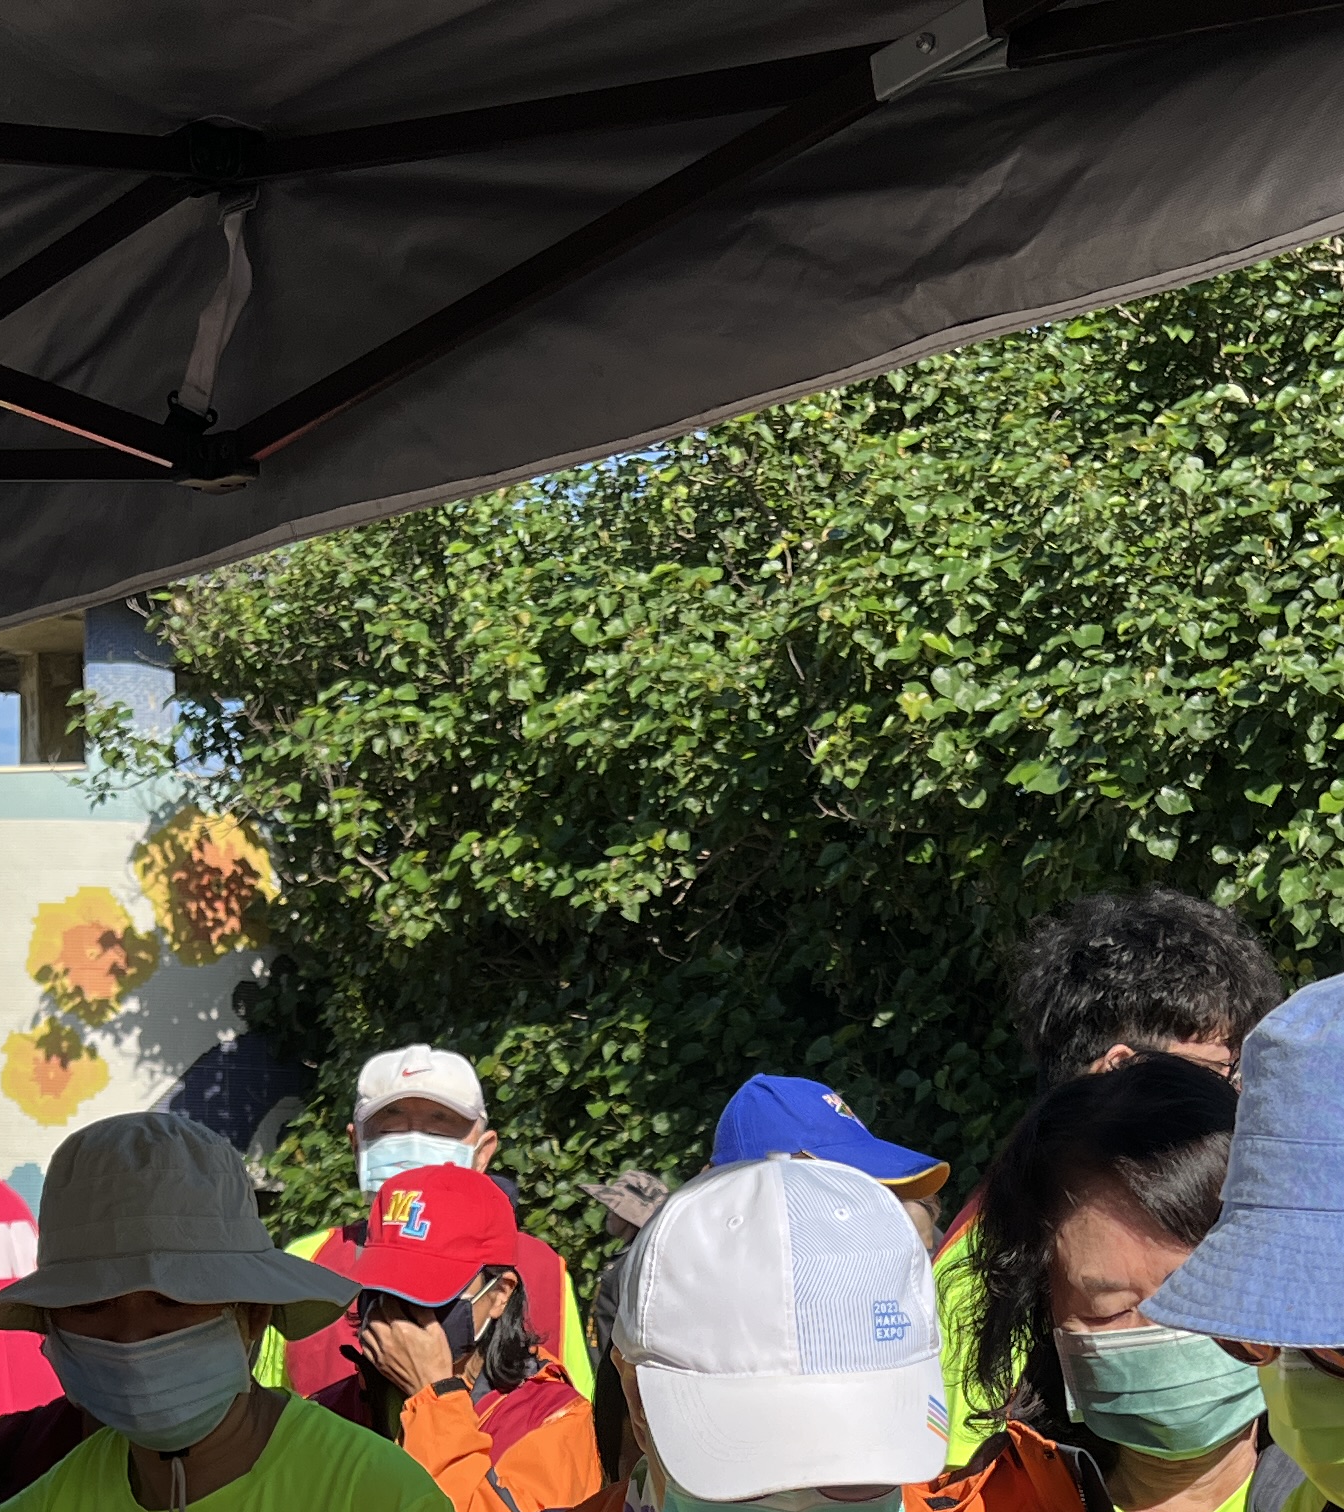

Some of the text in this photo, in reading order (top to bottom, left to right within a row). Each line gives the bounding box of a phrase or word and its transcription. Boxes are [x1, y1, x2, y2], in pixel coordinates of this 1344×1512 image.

[382, 1189, 431, 1241] ML
[875, 1313, 910, 1327] HAKKA
[876, 1327, 904, 1339] EXPO
